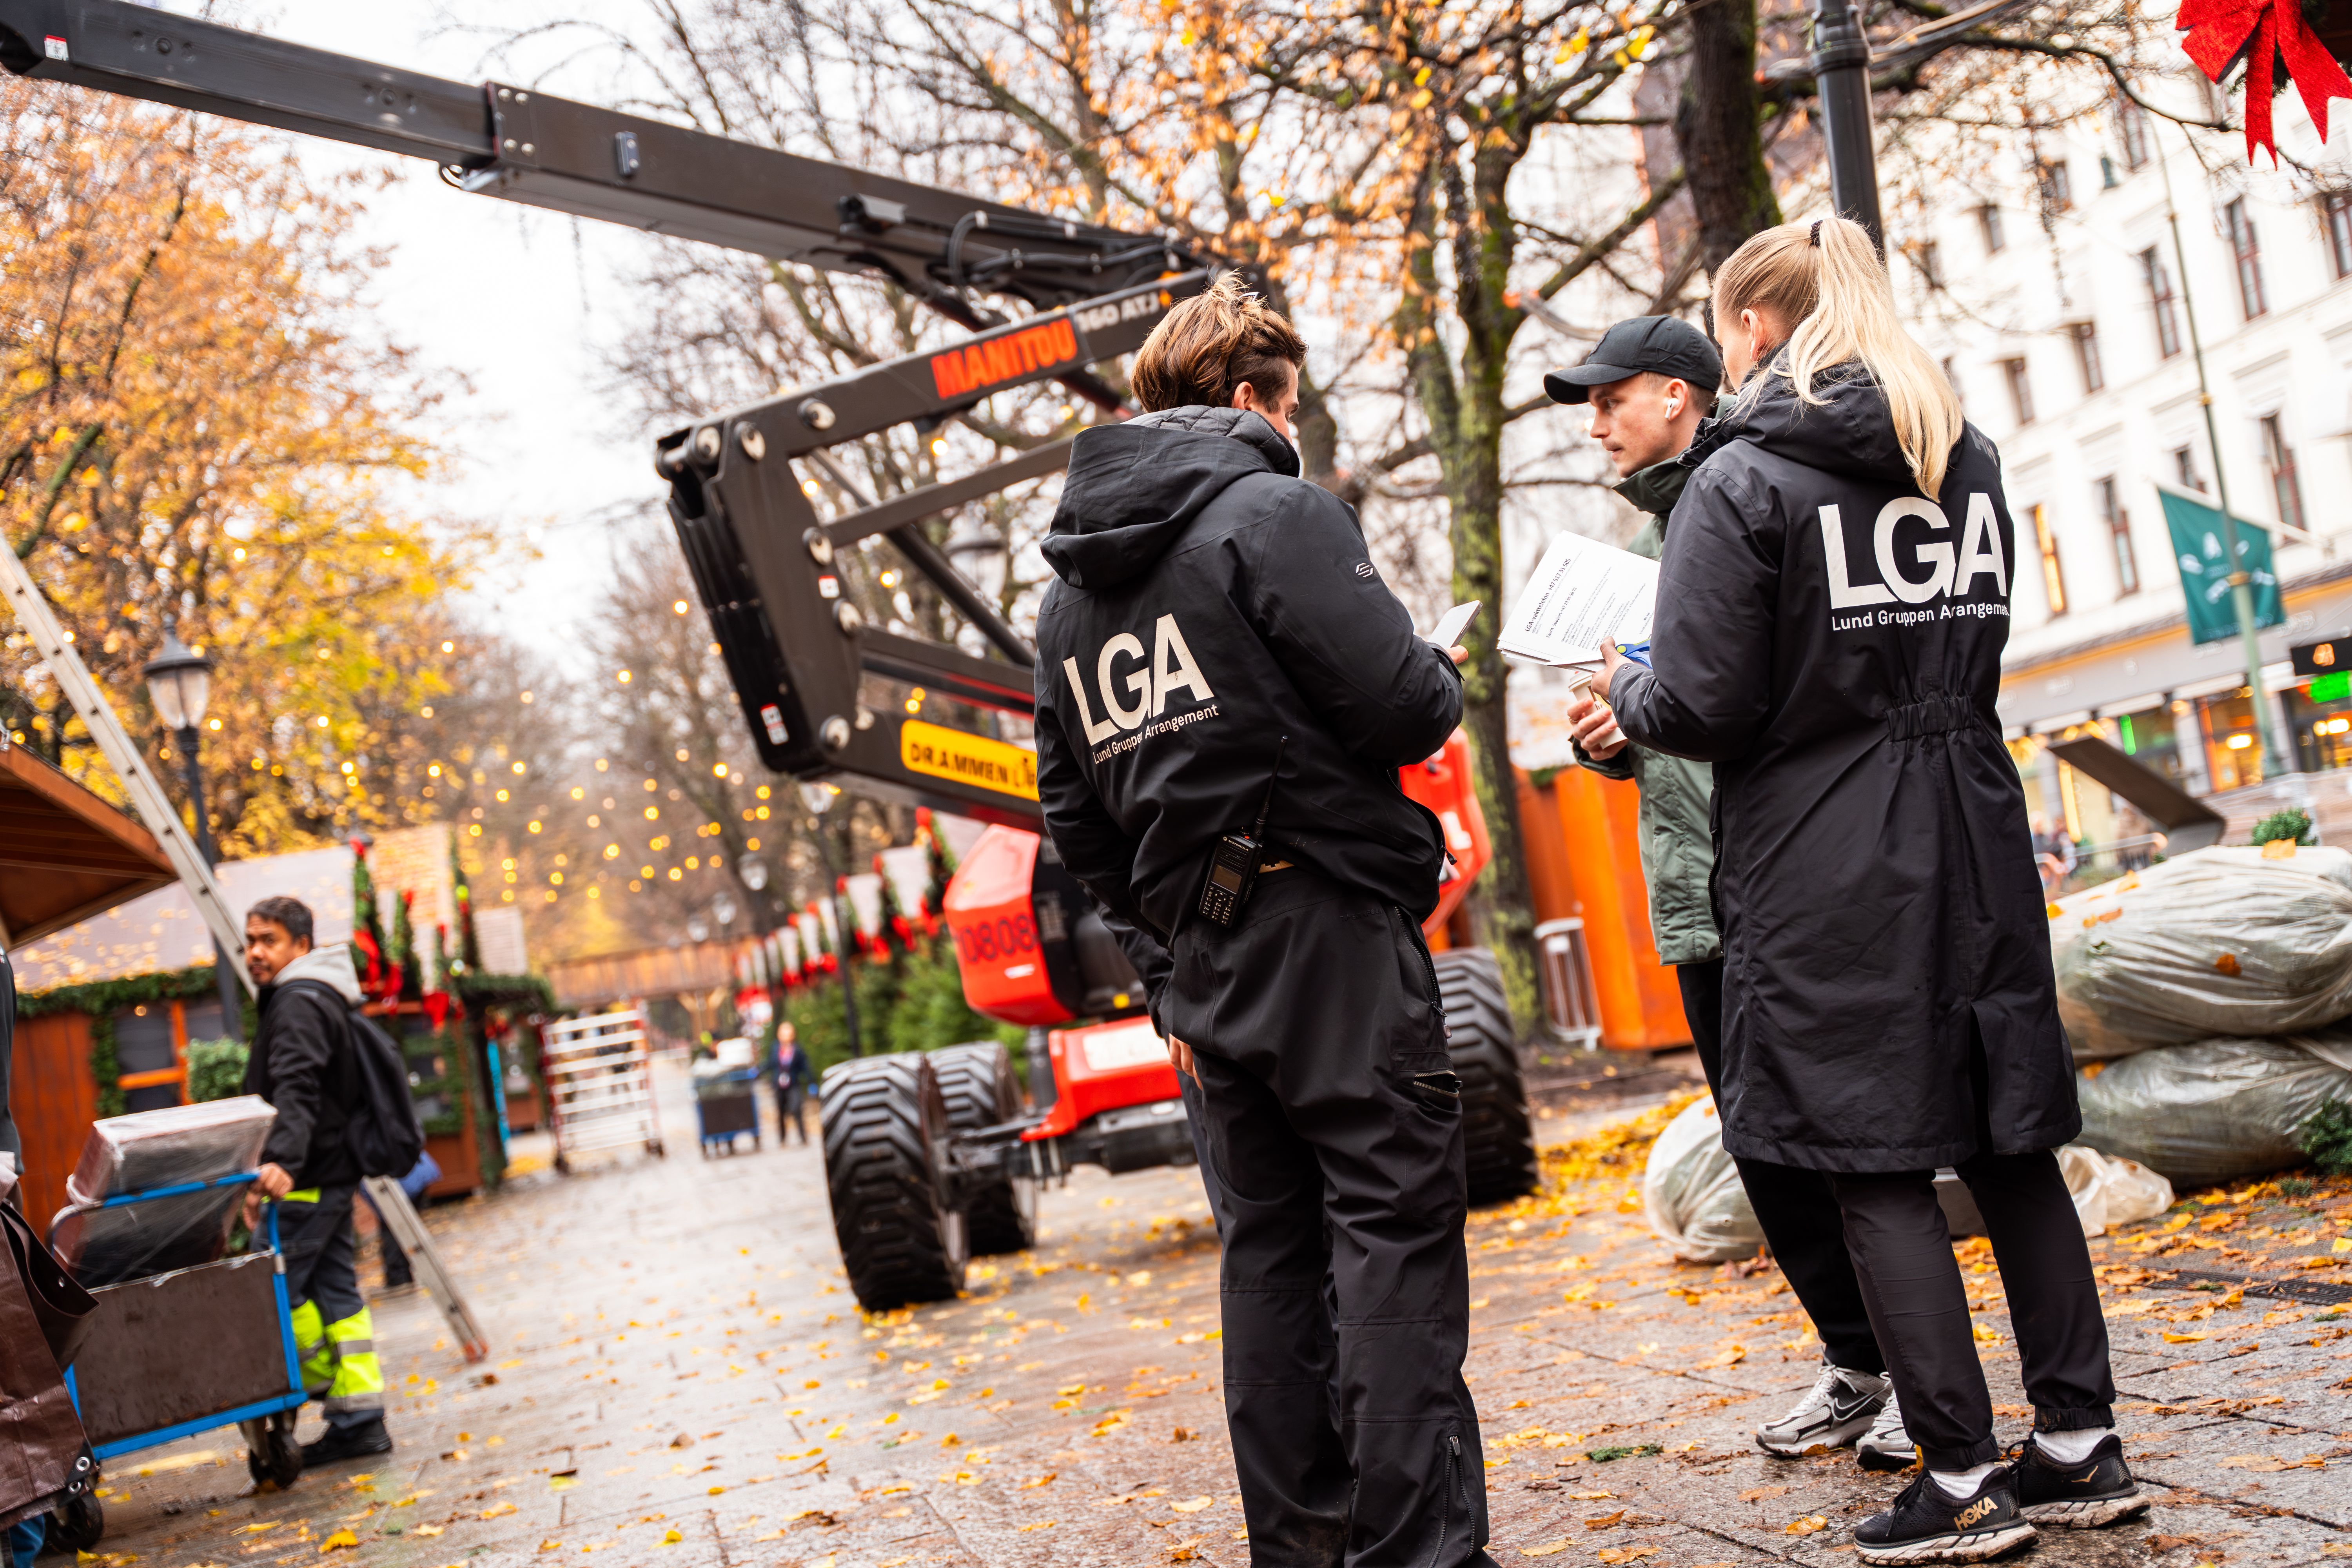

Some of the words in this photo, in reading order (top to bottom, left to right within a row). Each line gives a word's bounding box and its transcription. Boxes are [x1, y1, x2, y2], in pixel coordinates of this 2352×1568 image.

[1122, 292, 1160, 321] ATJ
[931, 318, 1078, 399] MANITOU
[1818, 492, 2007, 609] LGA
[1525, 593, 1550, 632] LGA-vakttelefon
[1553, 573, 1561, 582] 517
[1832, 612, 1873, 631] Lund
[1878, 609, 1934, 626] Gruppen
[1546, 628, 1554, 638] Favrit
[1552, 613, 1562, 626] Support
[1063, 613, 1215, 746] LGA
[1093, 745, 1112, 764] Lund
[1112, 731, 1143, 755] Gruppen
[1145, 704, 1219, 739] Arrangement
[910, 744, 1008, 783] DRAMMEN
[1228, 839, 1249, 851] MOTOROLA
[1953, 1496, 1998, 1532] HOKA
